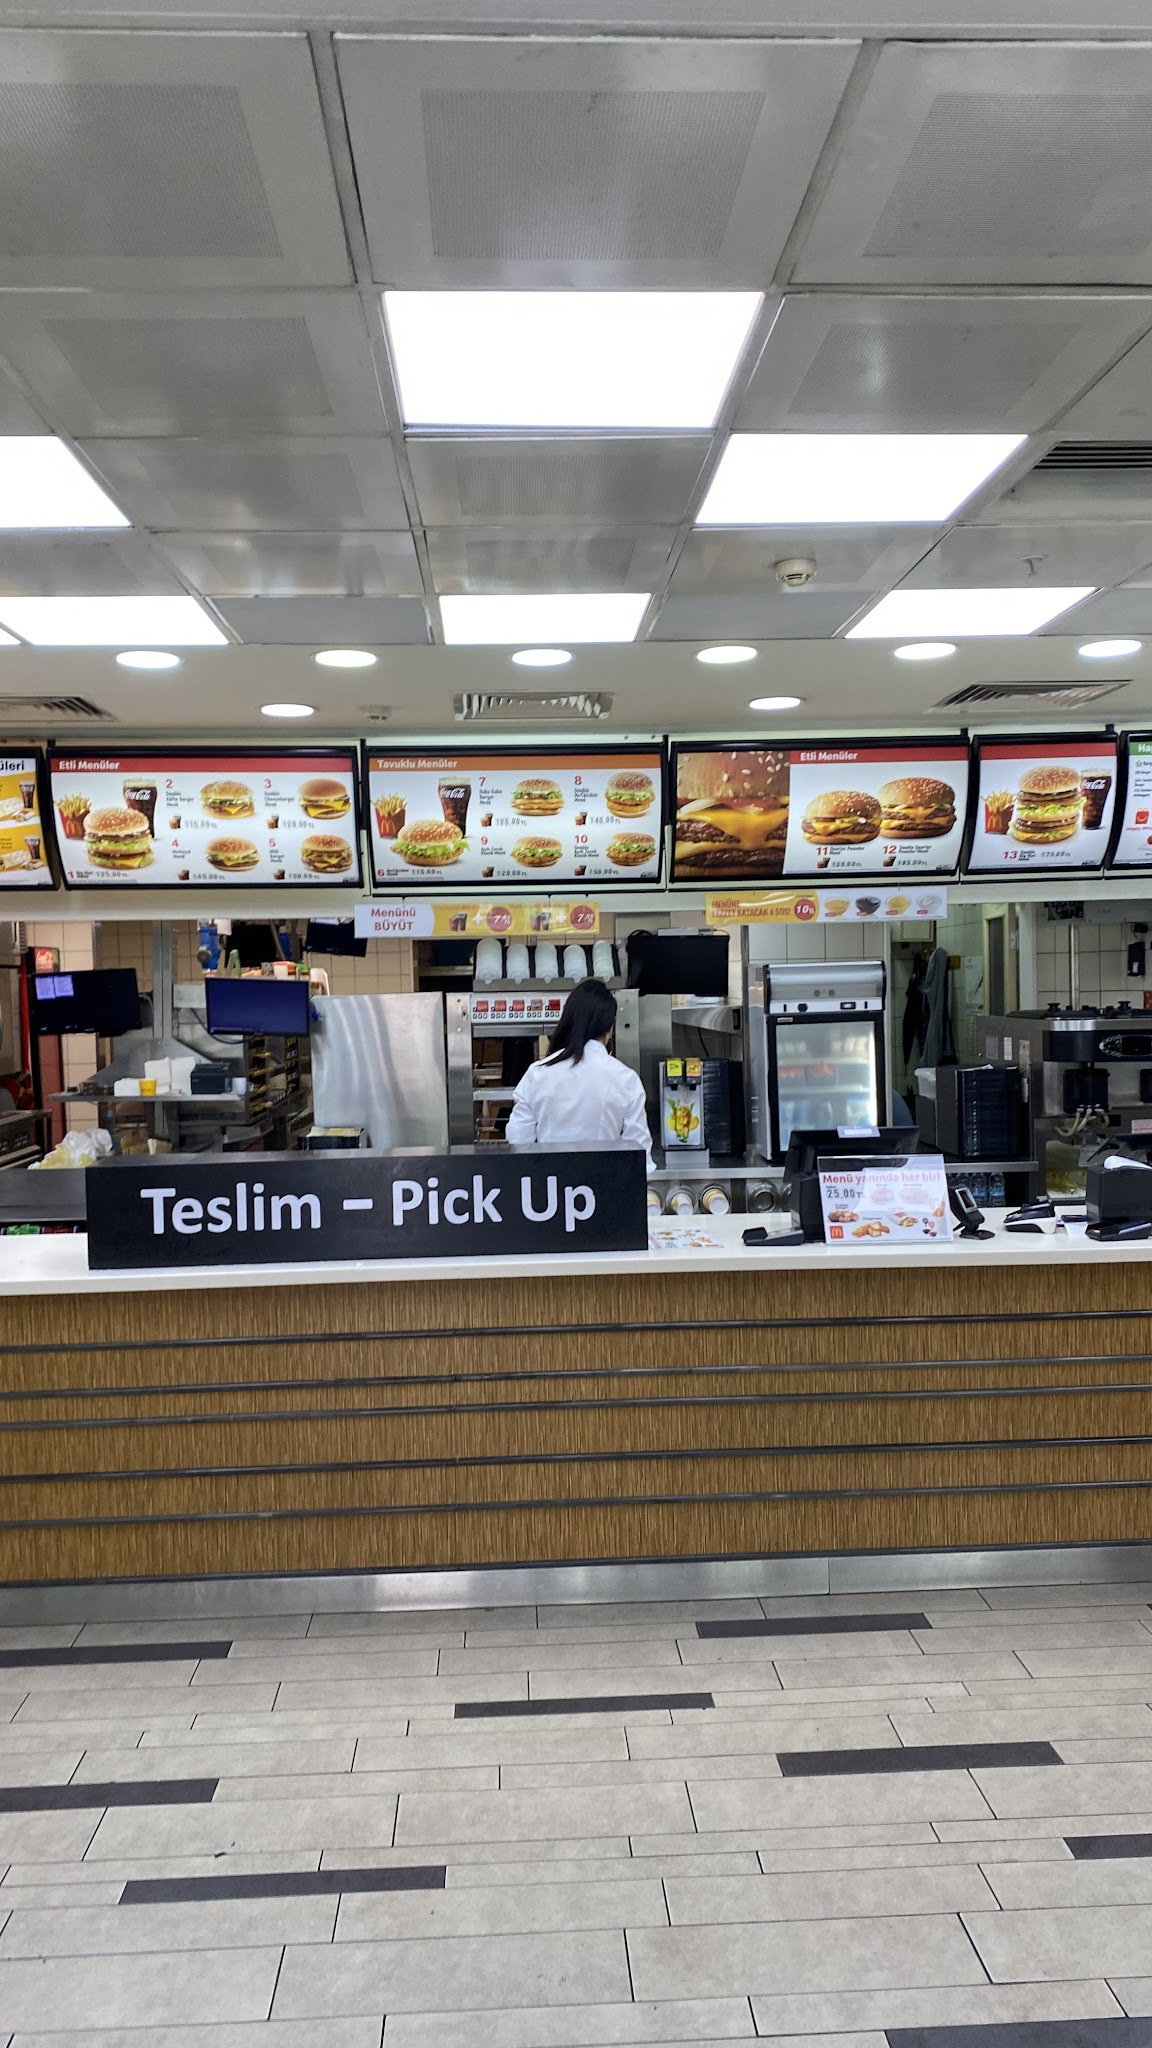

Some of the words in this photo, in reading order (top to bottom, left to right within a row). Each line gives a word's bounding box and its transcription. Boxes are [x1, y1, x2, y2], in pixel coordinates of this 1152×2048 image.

[800, 752, 817, 761] Etli
[818, 751, 858, 761] Menüler
[59, 760, 77, 770] Etli
[78, 760, 120, 770] Menüler
[378, 759, 416, 769] Tavuklu
[418, 759, 458, 769] Menüler
[165, 779, 173, 788] 2
[264, 778, 272, 789] 3
[479, 777, 487, 787] 7
[574, 775, 582, 785] 8
[171, 839, 179, 848] 4
[269, 838, 276, 848] 5
[481, 836, 488, 845] 9
[574, 835, 588, 844] 10
[816, 846, 829, 856] 11
[882, 845, 897, 855] 12
[1003, 850, 1018, 859] 13
[68, 871, 74, 879] 1
[377, 868, 385, 877] 6
[371, 907, 417, 918] Menünü
[374, 920, 415, 931] BÜYÜT
[823, 1173, 853, 1184] Menü
[901, 1172, 920, 1181] her
[140, 1182, 322, 1235] Teslim
[391, 1174, 503, 1226] Pick
[520, 1175, 596, 1232] Up
